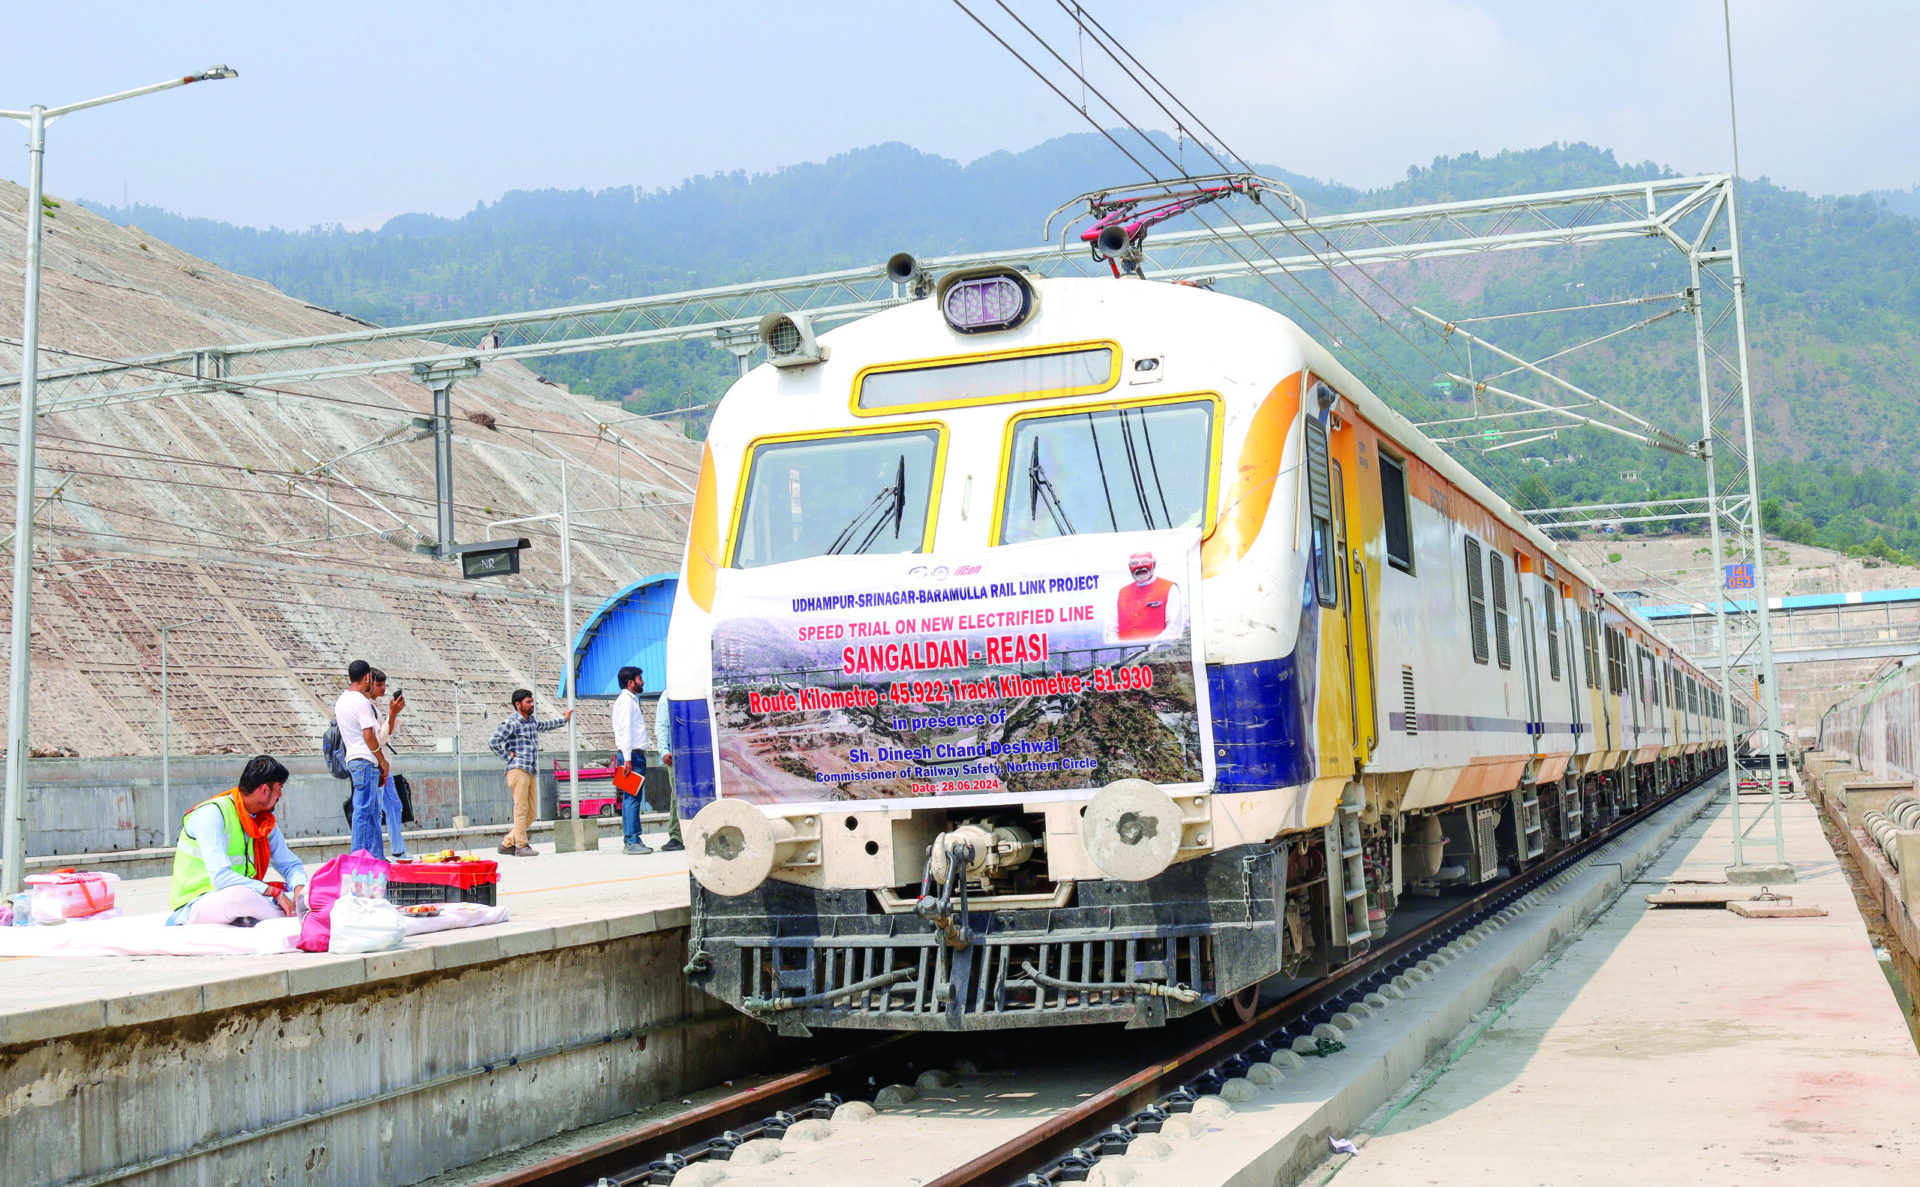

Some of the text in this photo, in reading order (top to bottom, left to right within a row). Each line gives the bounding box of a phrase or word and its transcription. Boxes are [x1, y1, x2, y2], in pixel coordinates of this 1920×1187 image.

[481, 557, 495, 570] NR
[1732, 565, 1747, 577] 141
[792, 575, 1099, 613] UDHAMPUR-SRINAGAR-BARAMULLA RAIL LINK PROJECT
[1728, 576, 1752, 588] 052
[798, 605, 1094, 641] SPEED TRIAL ON NEW ELECTRIFIED LINE
[843, 639, 968, 674] SANGALDAN
[986, 633, 1049, 665] REASI
[750, 690, 797, 714] Route
[799, 685, 878, 711] Kilometre
[890, 680, 949, 706] 45.922;
[952, 677, 996, 700] Track
[999, 672, 1082, 698] Kilometre
[1094, 665, 1152, 692] 51.930
[892, 709, 1006, 731] in presence of
[849, 737, 1059, 763] Sh. Dinesh Chand Deshwal
[816, 757, 1097, 783] Commissioner of Railway Safety, Northern Circle
[912, 779, 999, 793] Date: 28.06.2024
